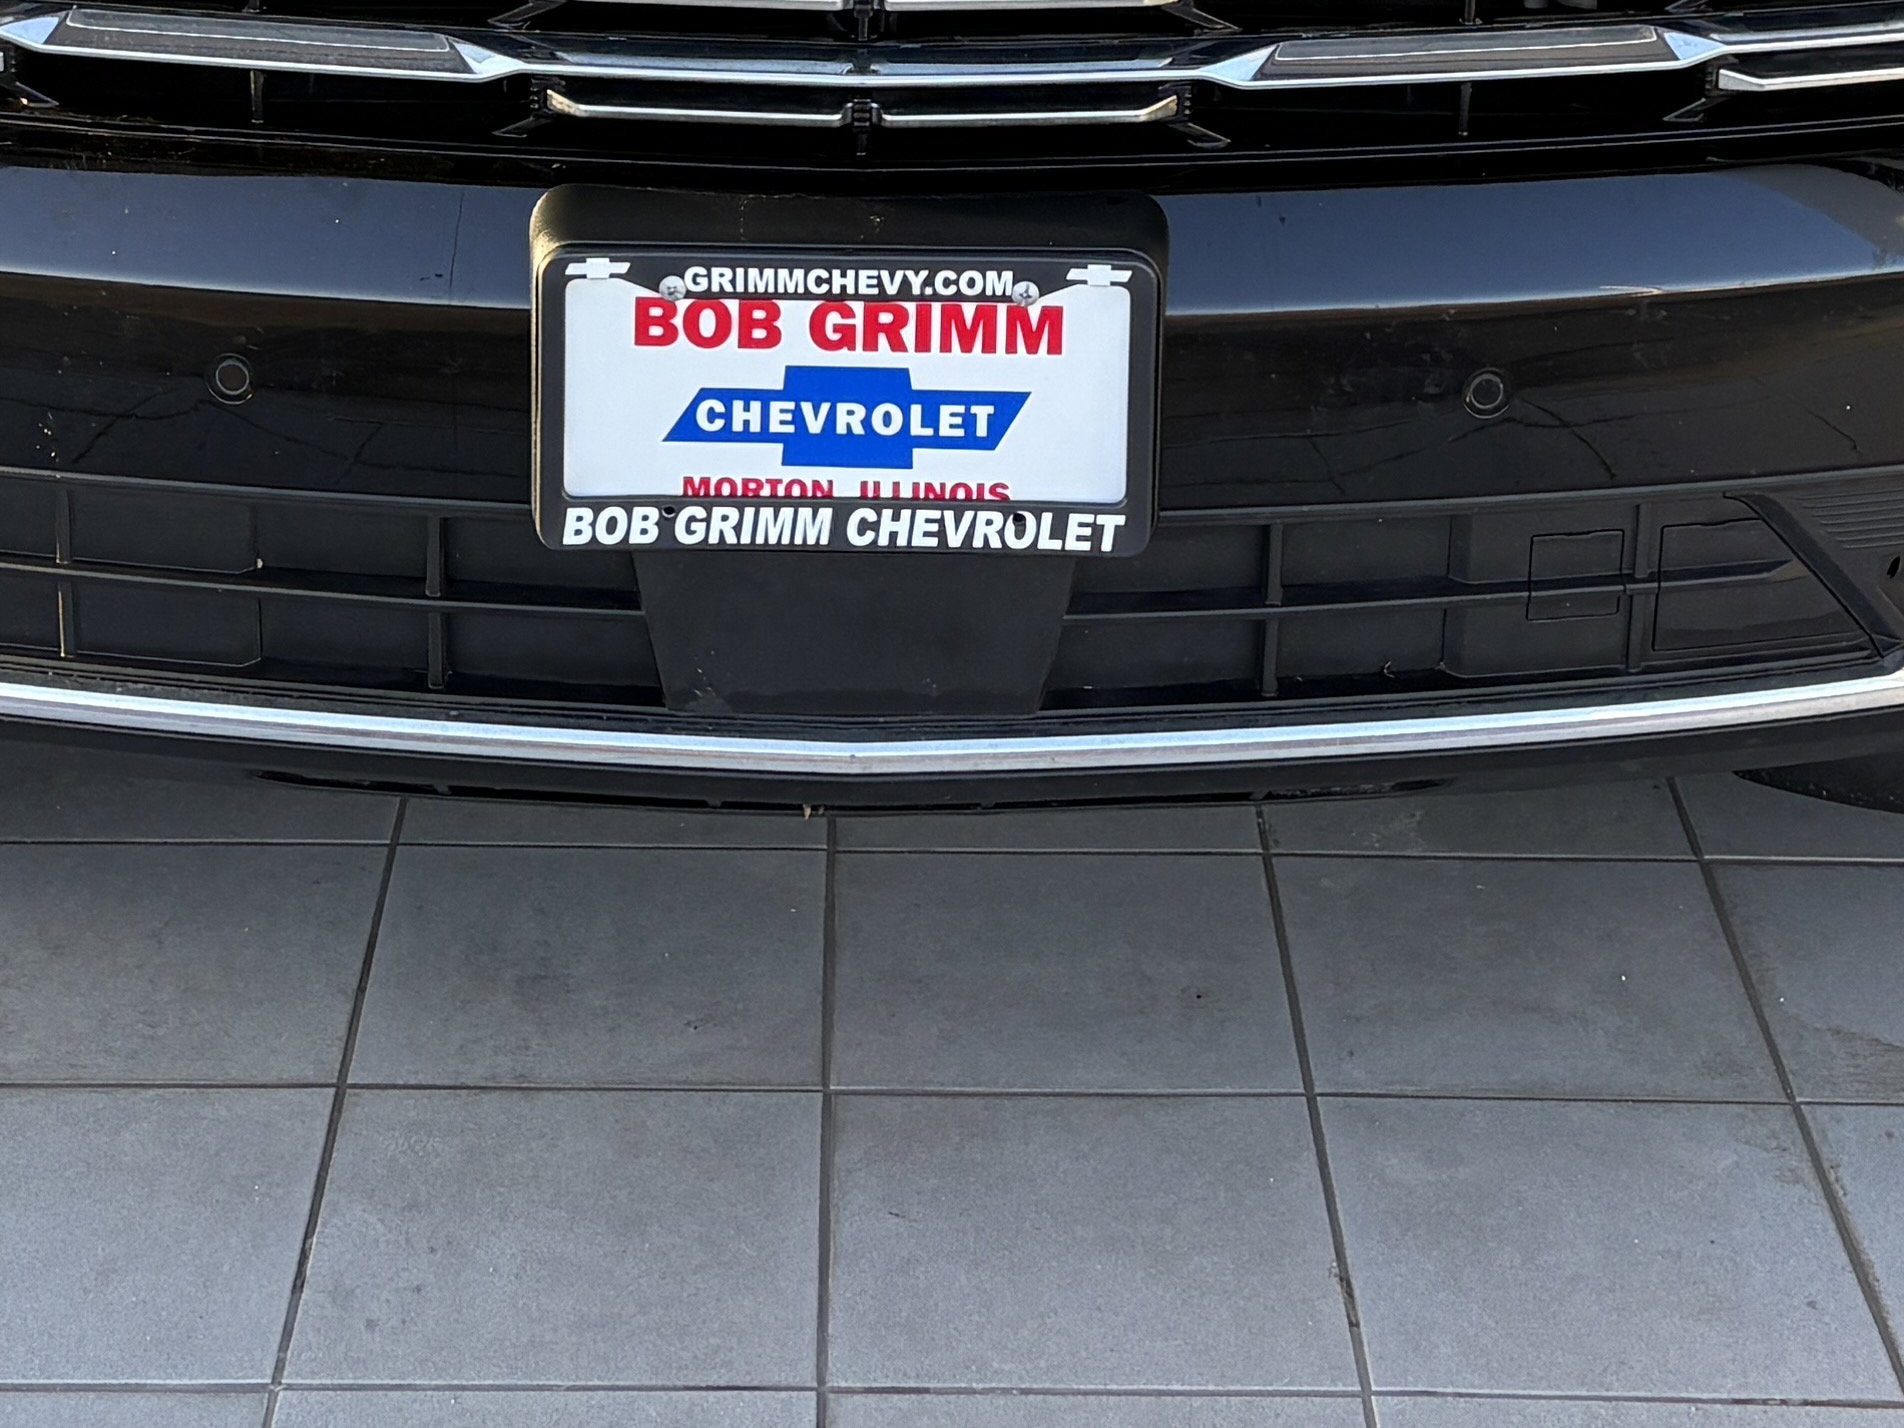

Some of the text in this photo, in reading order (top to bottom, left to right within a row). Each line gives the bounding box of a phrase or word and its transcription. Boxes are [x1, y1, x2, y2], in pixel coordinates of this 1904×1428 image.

[684, 266, 1014, 297] GRIMMCHEVY.COM
[634, 297, 1063, 355] BOB GRIMM
[696, 399, 994, 438] CHEVROLET
[563, 506, 1126, 553] BOB GRIMM CHEVROLET
